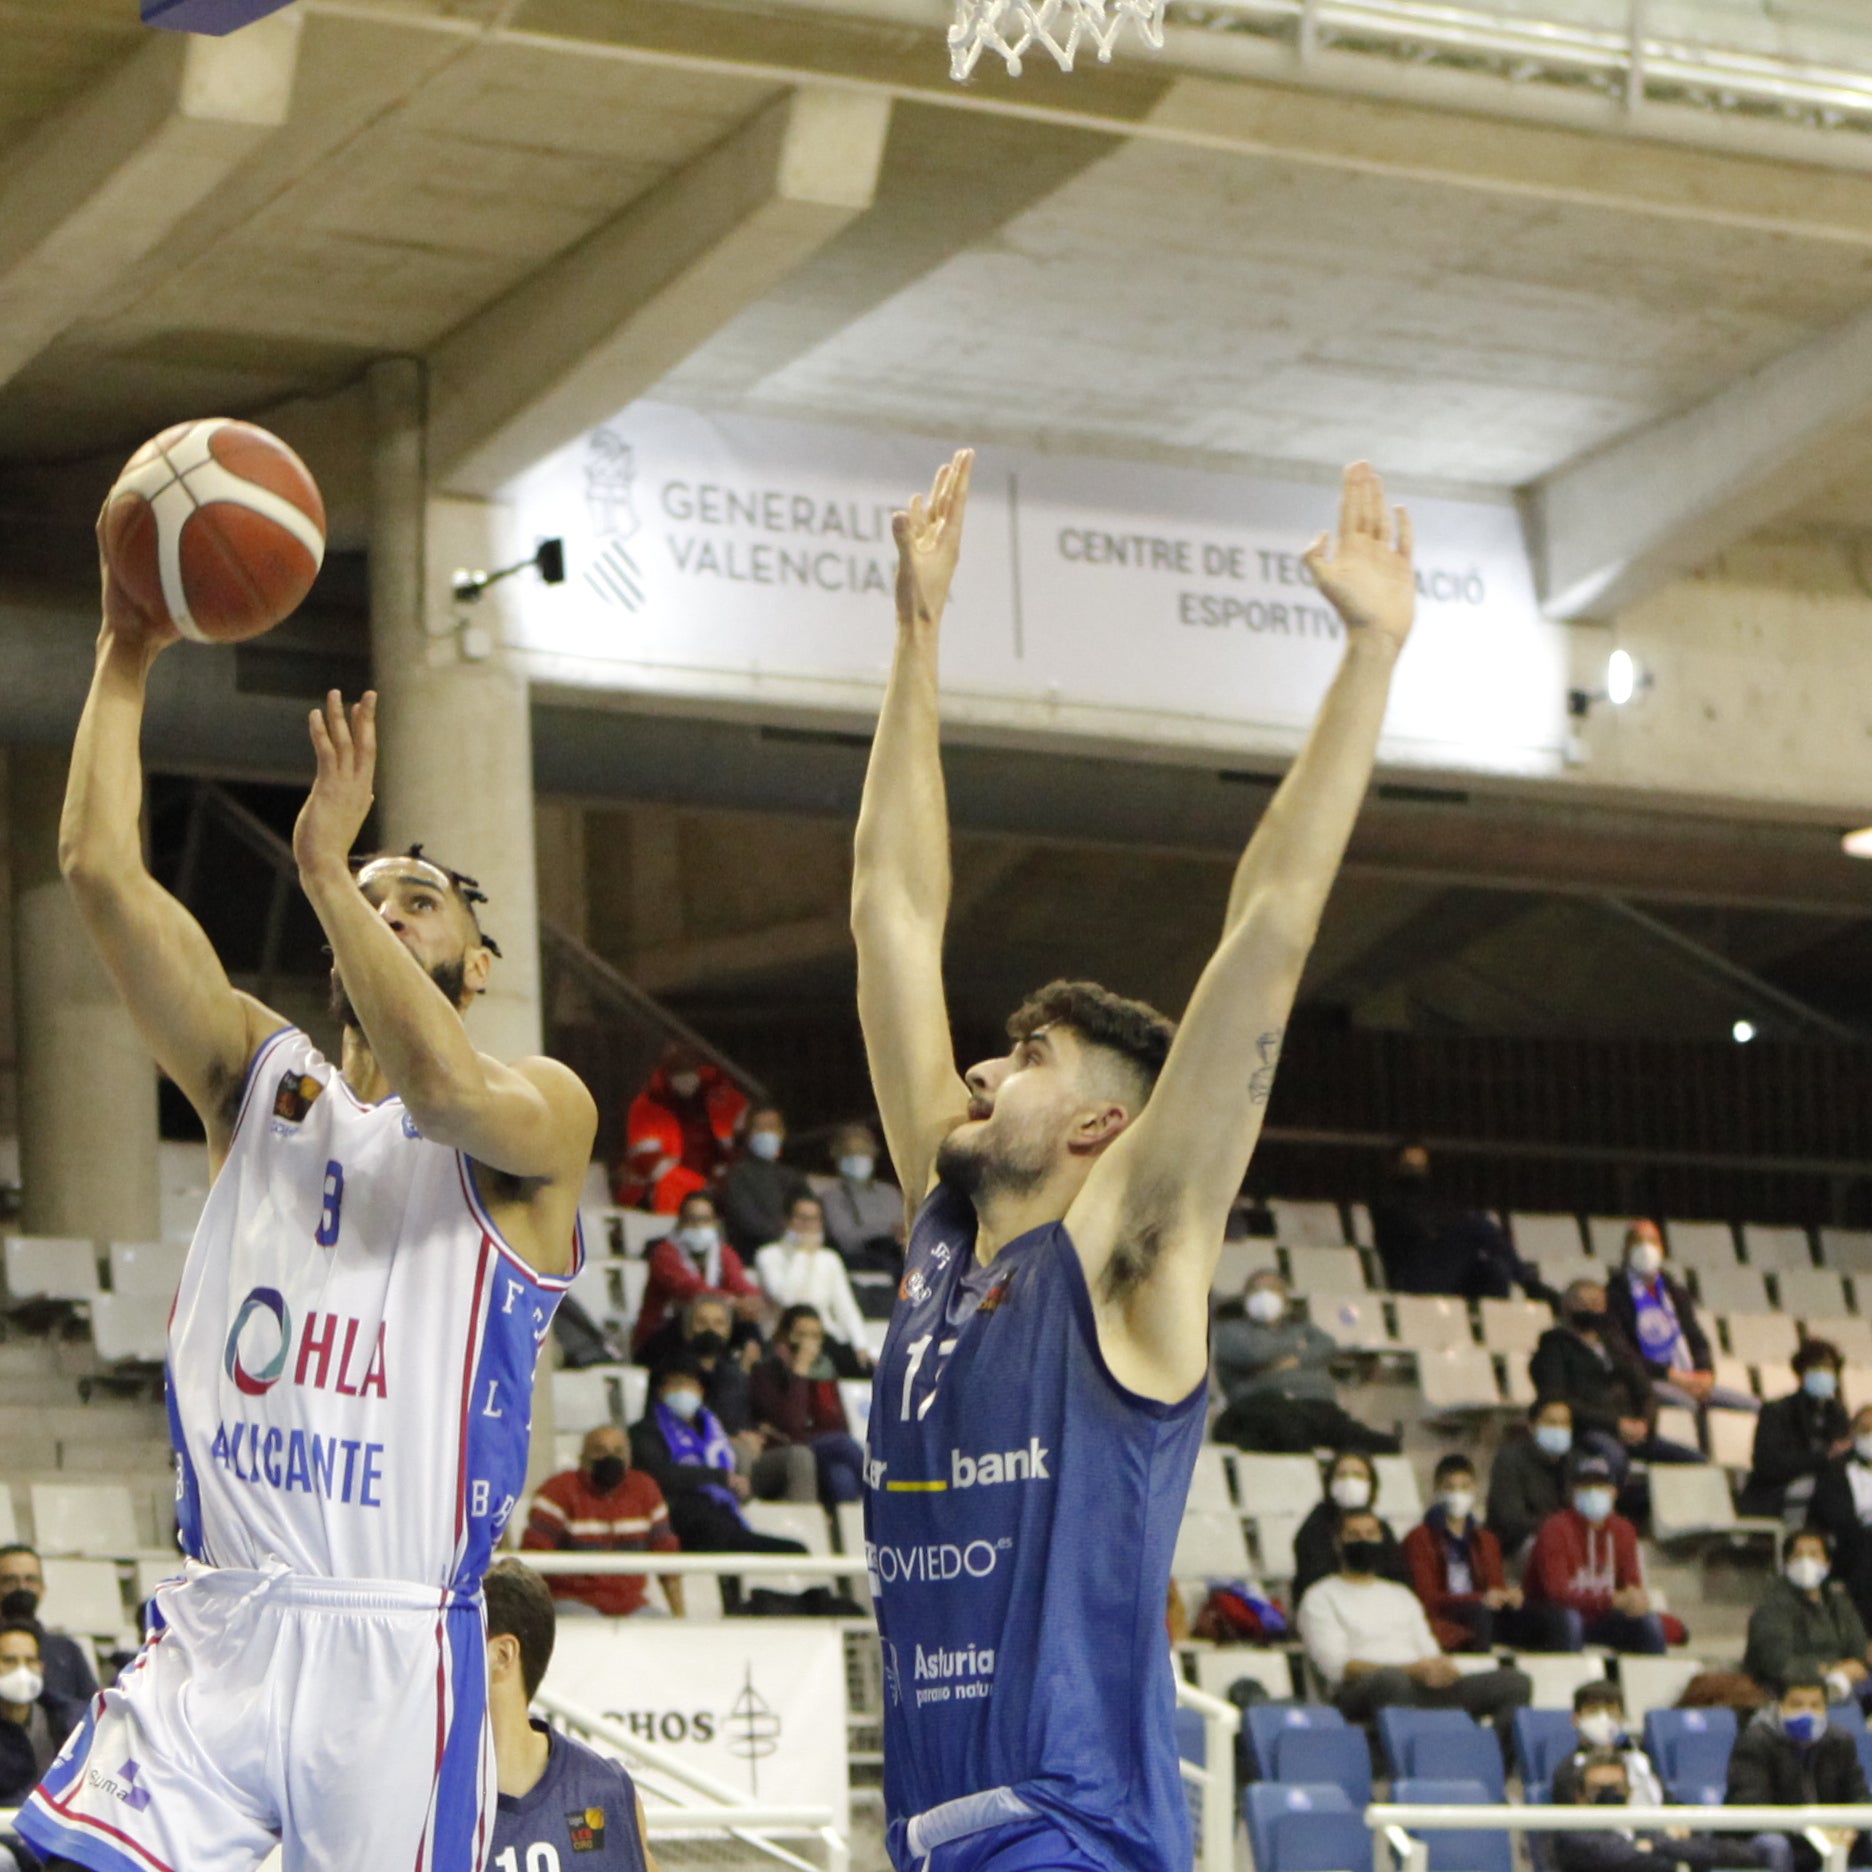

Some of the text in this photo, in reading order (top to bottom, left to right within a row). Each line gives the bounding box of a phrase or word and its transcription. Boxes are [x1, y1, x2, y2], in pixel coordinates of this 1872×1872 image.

[661, 480, 910, 543] GENERALI
[666, 534, 953, 603] VALENCIA
[1058, 527, 1192, 574] CENTRE
[1202, 545, 1246, 579] DE
[1178, 592, 1345, 641] ESPORTIV
[211, 1421, 384, 1507] ALICANTE
[951, 1437, 1050, 1489] bank
[914, 1643, 995, 1681] Asturia
